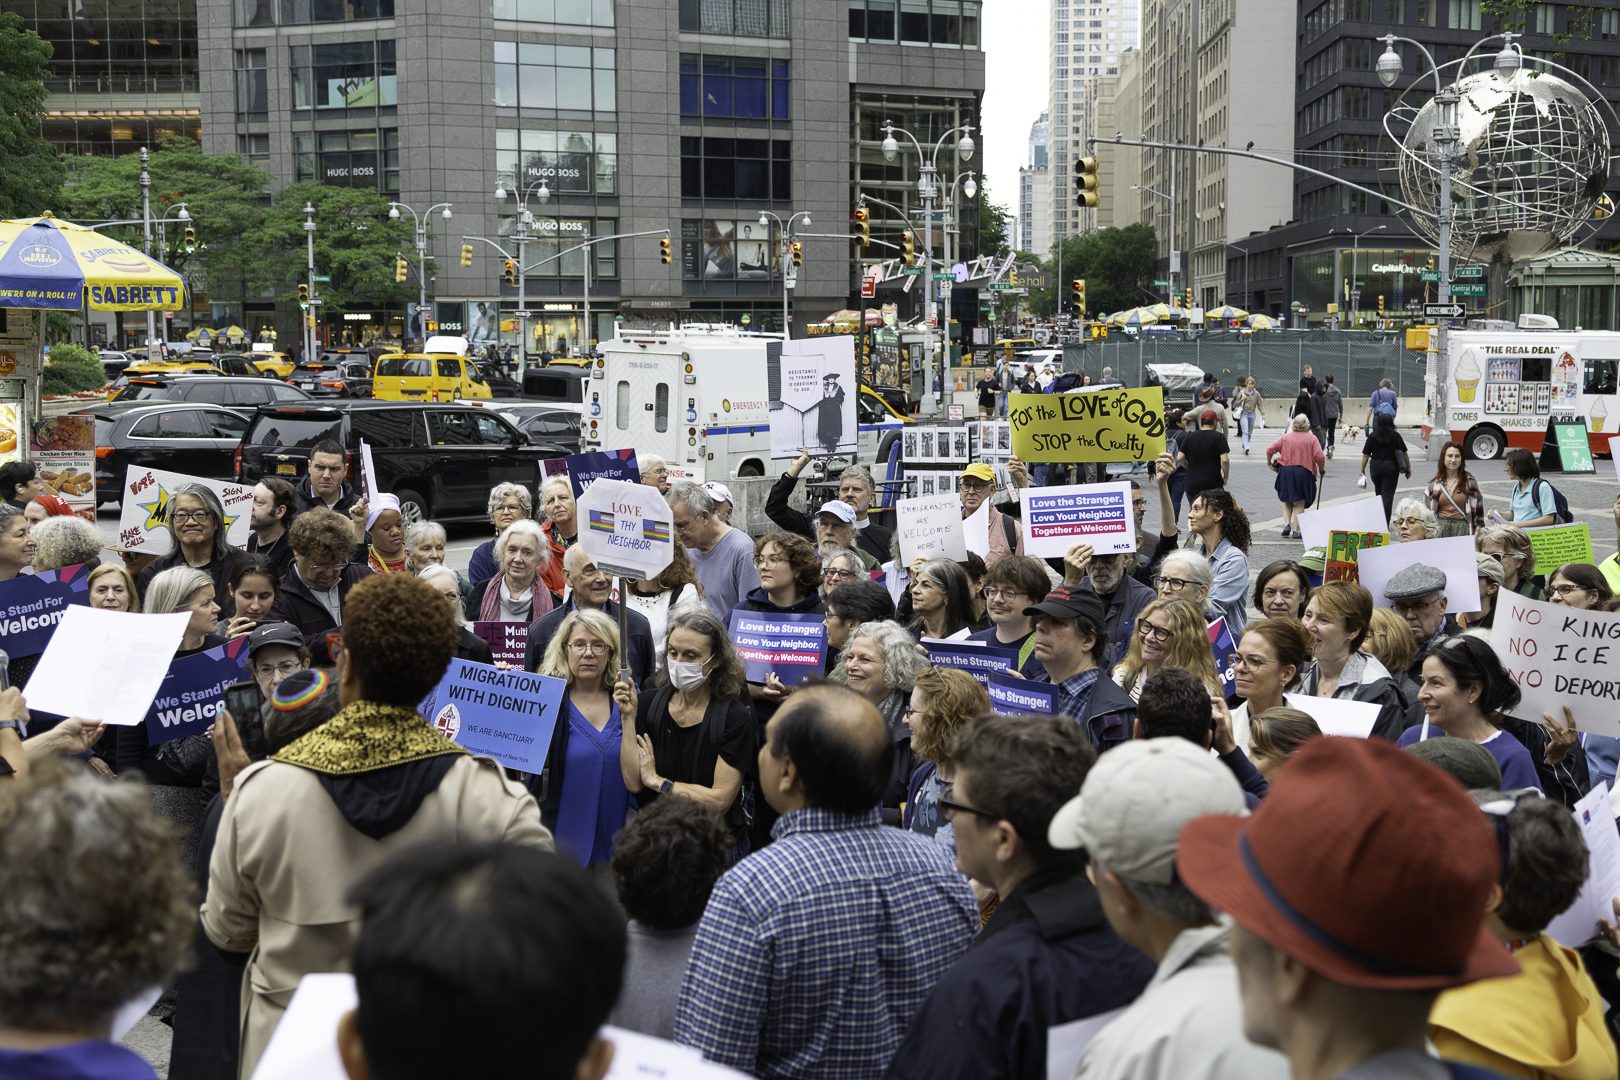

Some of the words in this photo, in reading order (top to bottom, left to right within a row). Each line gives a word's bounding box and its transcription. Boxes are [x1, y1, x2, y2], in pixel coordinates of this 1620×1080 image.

[353, 167, 374, 175] BOSS
[528, 168, 555, 176] HUGO
[1027, 276, 1045, 286] hall
[0, 290, 24, 298] WE'RE
[91, 284, 179, 304] SABRETT
[1010, 406, 1033, 431] For
[1036, 405, 1056, 420] the
[1058, 396, 1110, 421] LOVE
[1111, 392, 1128, 418] of
[1124, 399, 1164, 438] GOD
[1453, 413, 1478, 421] CONES
[1500, 418, 1533, 427] SHAKES
[1032, 433, 1072, 451] STOP
[1077, 435, 1096, 447] the
[1095, 428, 1145, 459] Cruelty
[591, 471, 608, 479] Stand
[130, 472, 155, 496] VOTE
[222, 486, 243, 498] SIGN
[224, 492, 253, 507] PETITIONS
[901, 502, 955, 514] IMMIGRANTS
[1032, 500, 1056, 508] Love
[1058, 498, 1074, 506] the
[1075, 495, 1122, 505] Stranger.
[611, 502, 642, 517] LOVE
[1032, 514, 1055, 522] Love
[1056, 512, 1077, 521] Your
[1078, 510, 1123, 520] Neighbor.
[620, 520, 636, 532] THY
[903, 526, 952, 539] WELCOME
[1033, 526, 1072, 536] Together
[1081, 524, 1125, 532] Welcome.
[120, 526, 141, 543] MAKE
[124, 536, 145, 548] CALLS
[608, 535, 651, 551] NEIGHBOR
[1331, 533, 1384, 562] FREE
[8, 600, 44, 617] Stand
[45, 596, 64, 608] For
[1512, 606, 1542, 625] NO
[740, 622, 764, 632] Love
[781, 625, 821, 635] Stranger.
[737, 636, 759, 645] Love
[761, 639, 780, 648] Your
[781, 640, 819, 650] Neighbor.
[1509, 637, 1537, 657] NO
[1553, 644, 1610, 664] ICE
[736, 650, 773, 661] Together
[780, 654, 818, 663] Welcome.
[930, 654, 952, 664] Love
[953, 656, 969, 665] the
[970, 657, 1010, 671] Stranger.
[460, 665, 542, 694] MIGRATION
[1508, 668, 1543, 688] NO
[155, 697, 180, 711] We
[181, 684, 221, 703] Stand
[222, 677, 238, 692] For
[449, 685, 485, 705] WITH
[488, 693, 548, 717] DIGNITY
[996, 688, 1006, 701] the
[1006, 691, 1049, 709] Stranger.
[158, 700, 226, 728] Welco
[468, 724, 478, 733] WE
[479, 726, 492, 736] ARE
[494, 729, 534, 745] SANCTUARY
[464, 744, 484, 754] Episcopal
